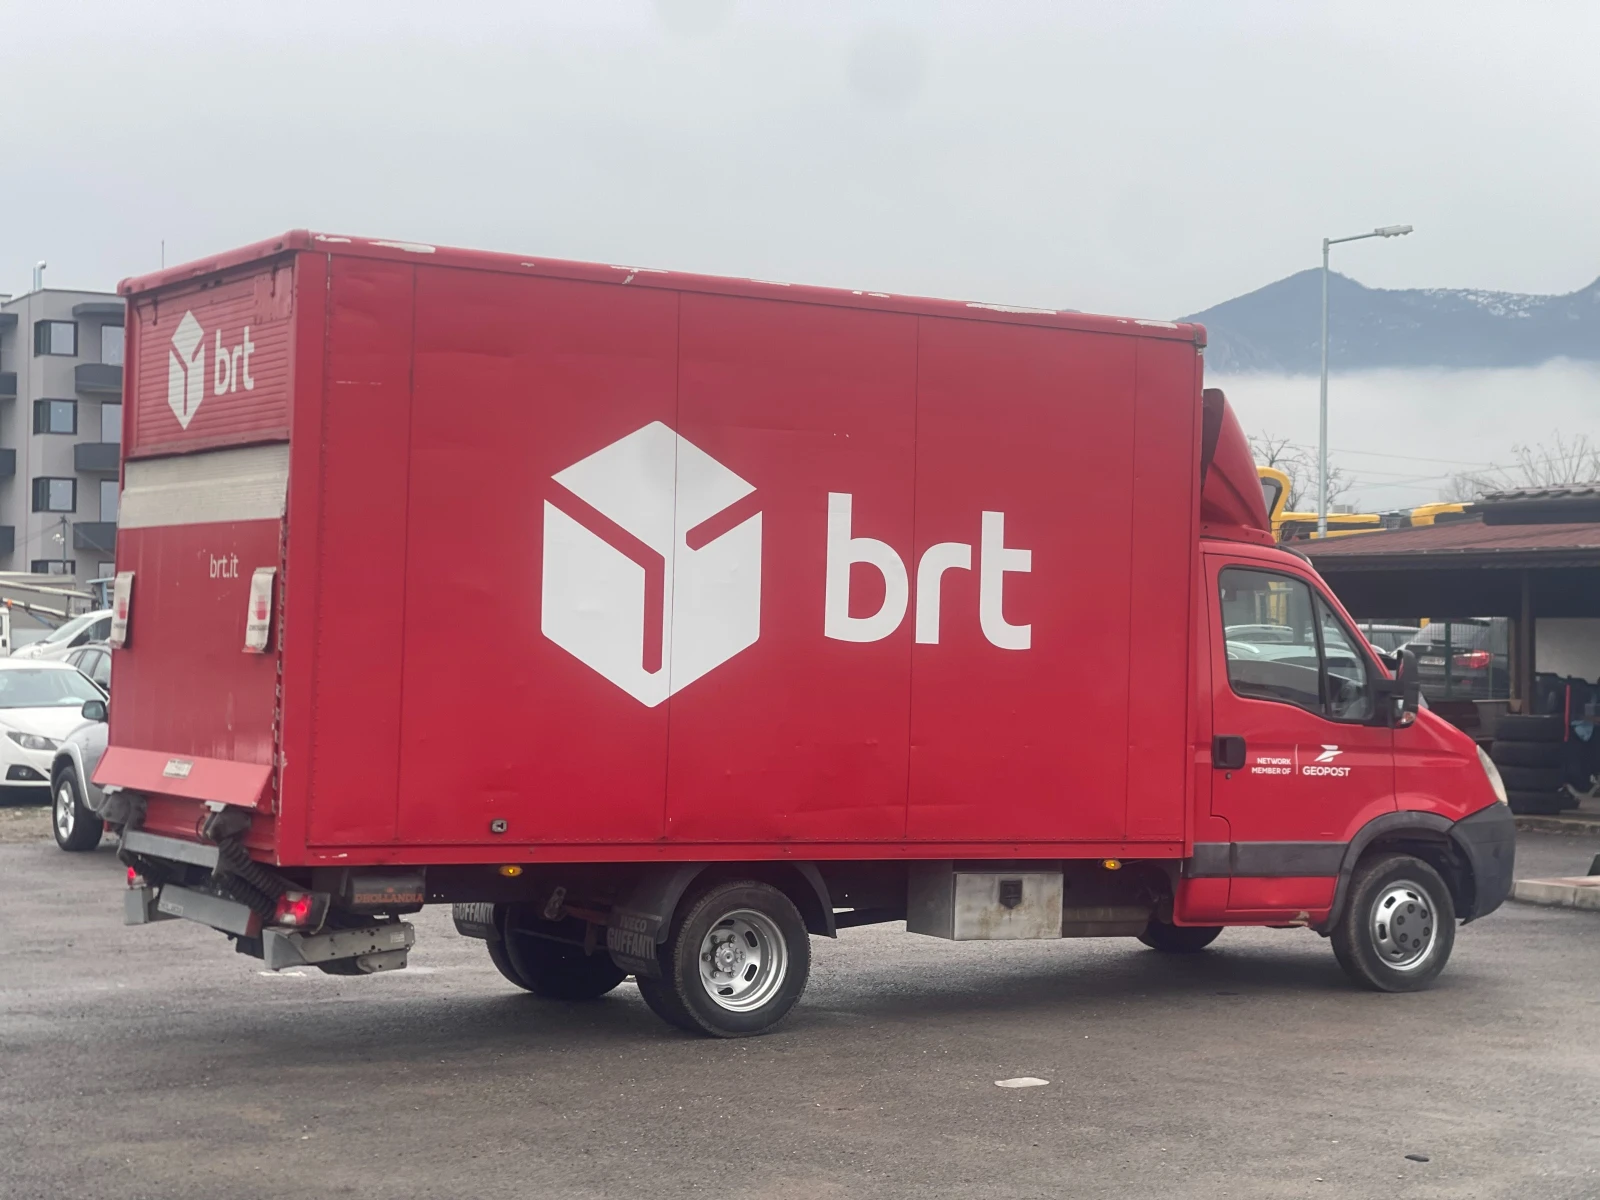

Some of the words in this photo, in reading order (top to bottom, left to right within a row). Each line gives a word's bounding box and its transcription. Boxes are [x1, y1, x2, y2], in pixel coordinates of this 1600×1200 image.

[214, 326, 254, 395] brt
[210, 552, 239, 578] brt.it
[824, 491, 1032, 650] brt
[1257, 757, 1291, 765] NETWORK
[1251, 767, 1281, 775] MEMBER
[1281, 767, 1291, 775] OF
[1302, 766, 1351, 777] GEOPOST
[353, 893, 424, 904] DHOLLANDIA
[620, 915, 647, 933] IVECO
[607, 927, 655, 960] GUFFANTI
